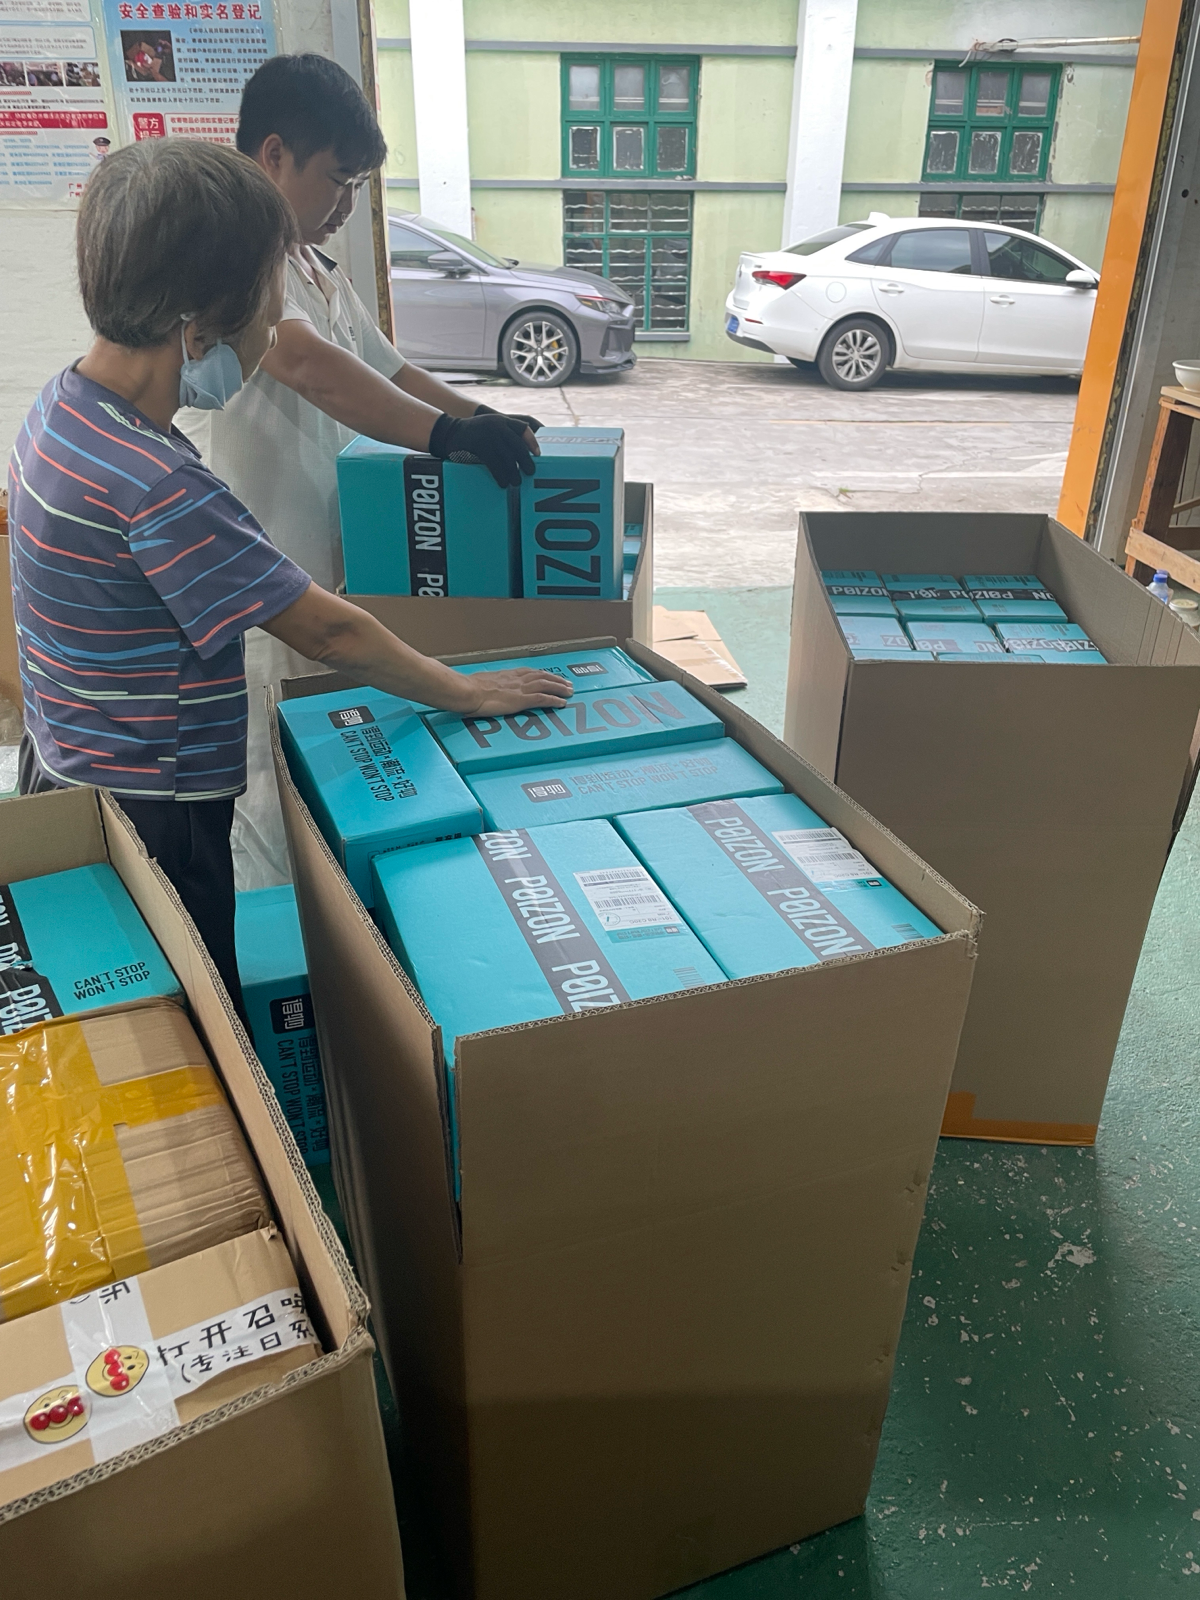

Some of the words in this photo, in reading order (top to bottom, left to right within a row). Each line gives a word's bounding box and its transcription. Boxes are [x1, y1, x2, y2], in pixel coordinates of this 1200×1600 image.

[119, 3, 262, 20] 安全查验和实名登记
[138, 117, 159, 129] 警方
[341, 730, 360, 748] CAN'T
[350, 744, 373, 764] STOP
[359, 762, 384, 785] WON'T
[611, 776, 646, 791] STOP
[689, 765, 718, 778] STOP
[370, 781, 395, 802] STOP
[73, 972, 111, 991] CAN'T
[114, 961, 146, 978] STOP
[73, 981, 116, 1001] WON'T
[118, 970, 151, 987] STOP
[277, 1039, 298, 1069] CAN'T
[282, 1070, 301, 1095] STOP
[285, 1098, 306, 1128] WON'T
